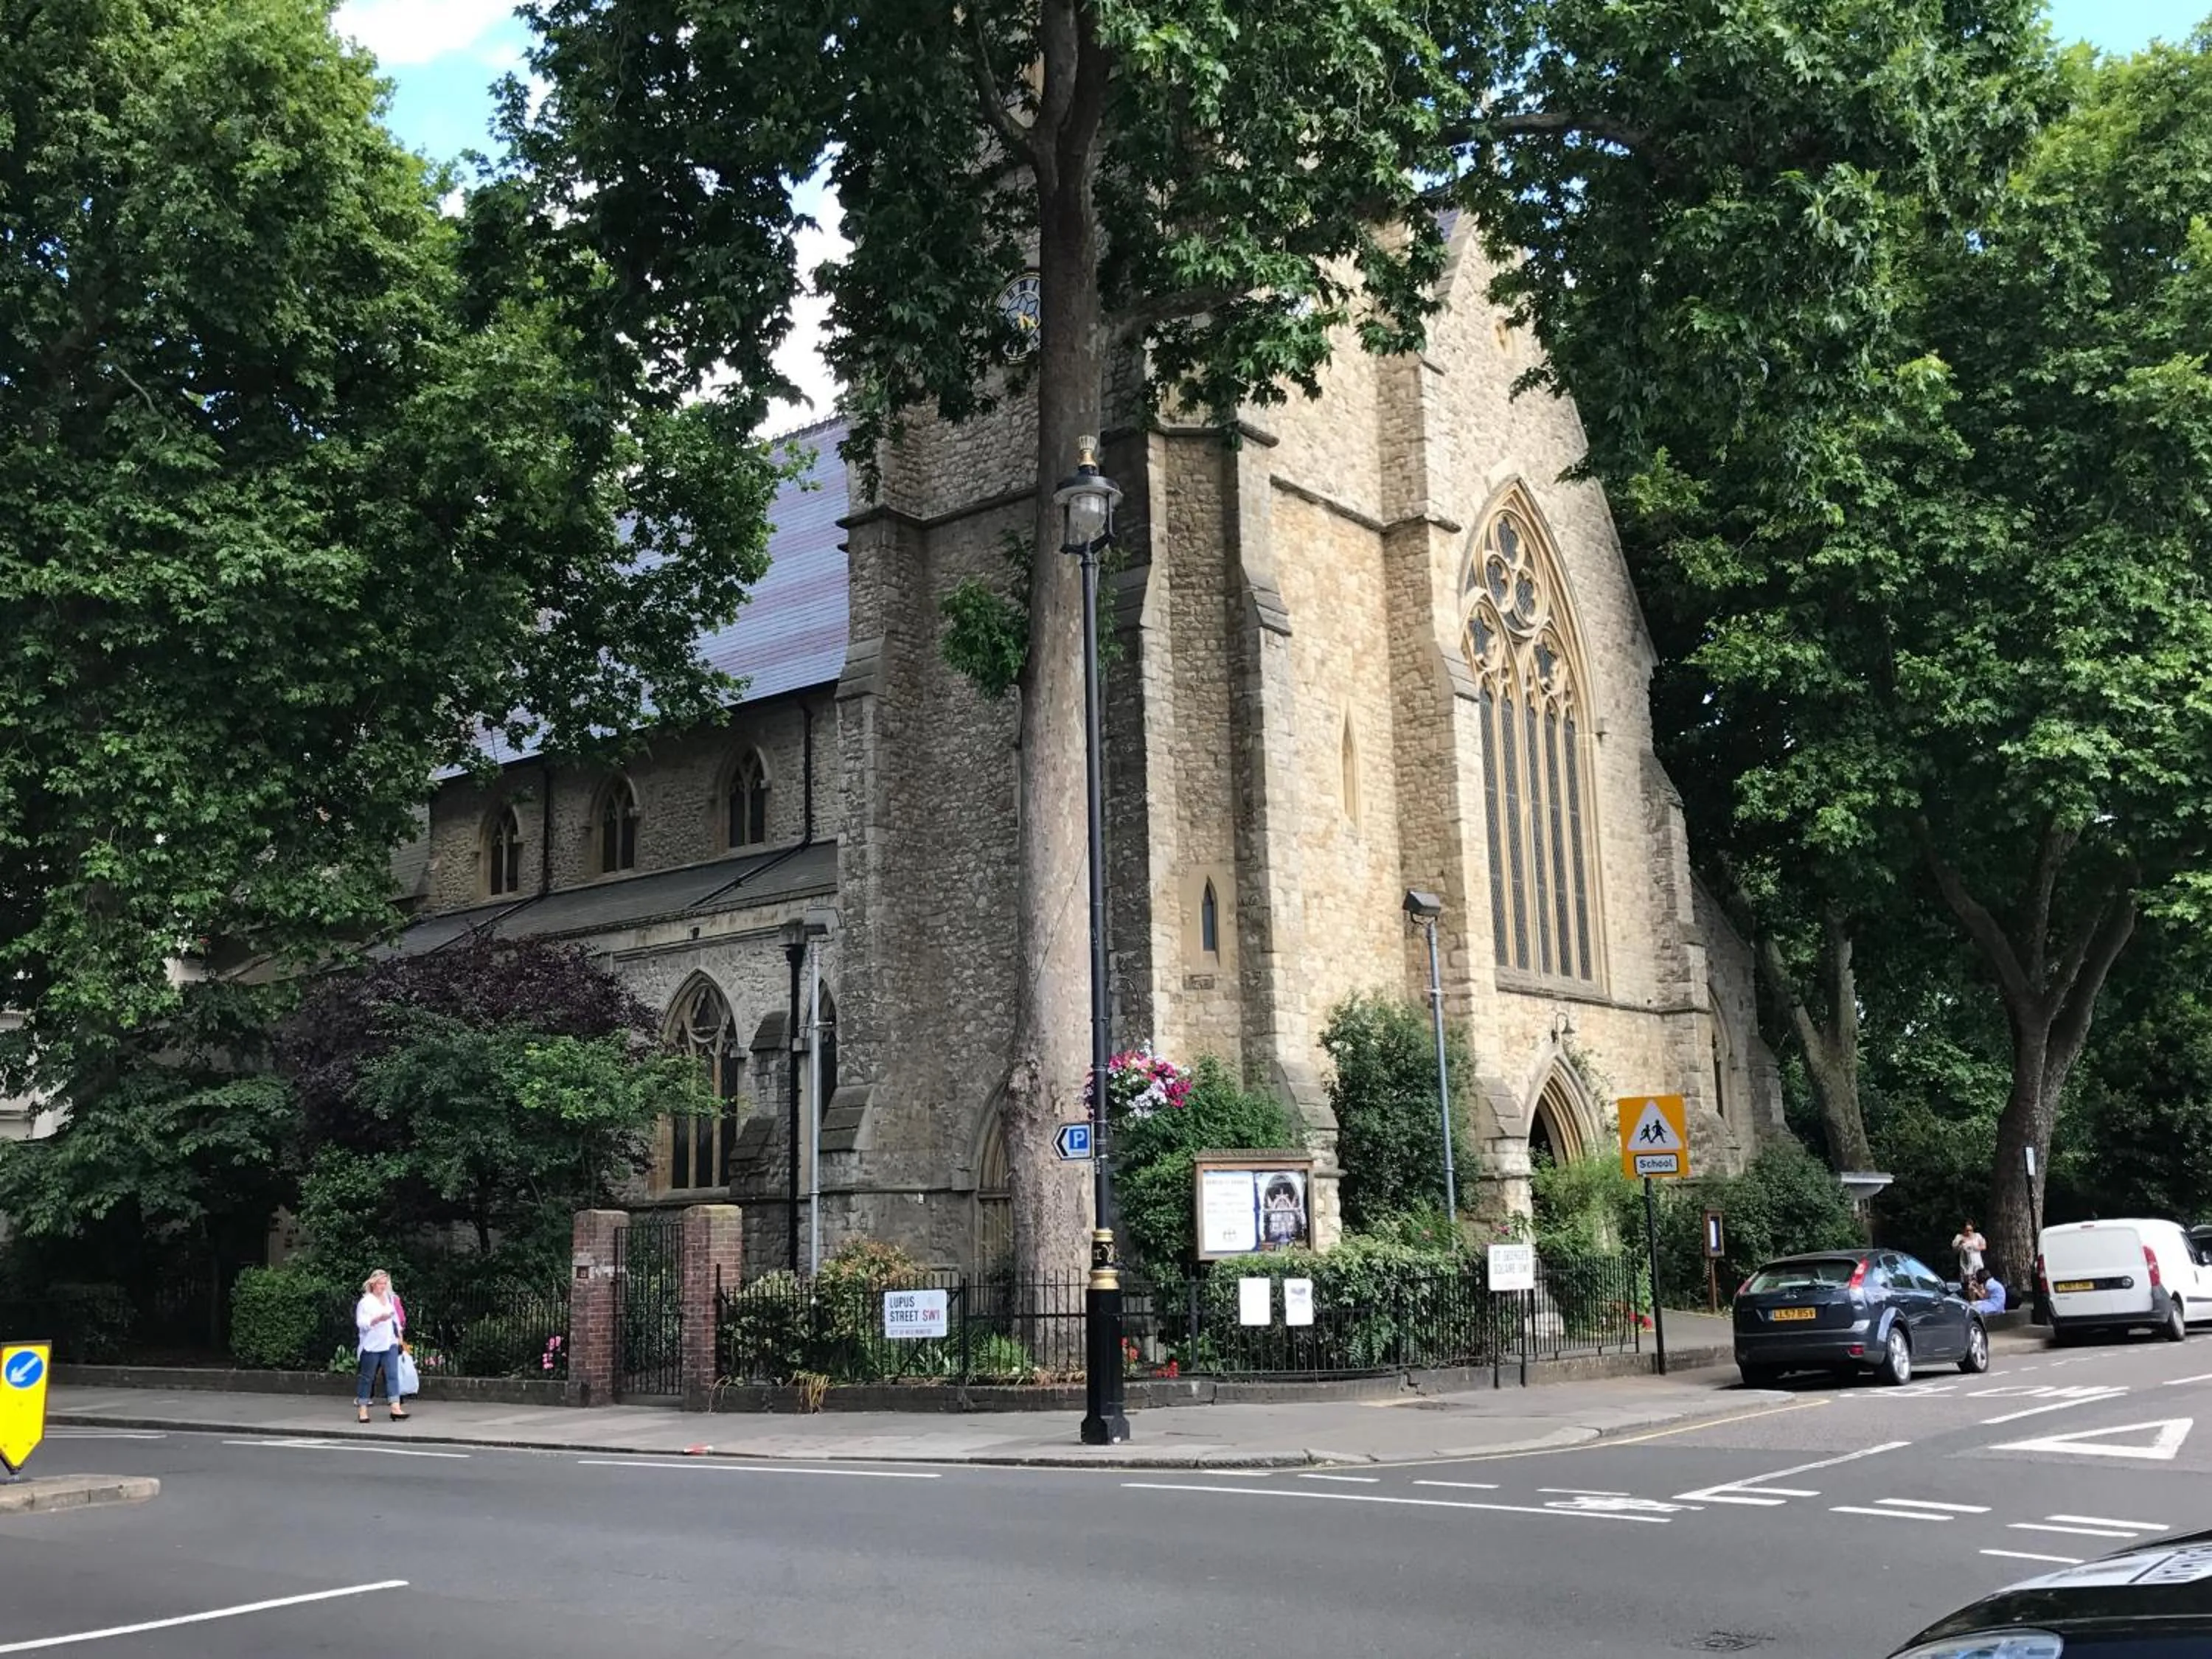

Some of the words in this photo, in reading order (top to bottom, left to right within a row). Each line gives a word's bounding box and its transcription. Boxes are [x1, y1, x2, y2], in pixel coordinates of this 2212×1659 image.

[1074, 1131, 1085, 1148] P
[1640, 1158, 1673, 1169] School
[889, 1295, 915, 1308] LUPUS
[890, 1310, 919, 1322] STREET
[922, 1310, 940, 1321] SW1
